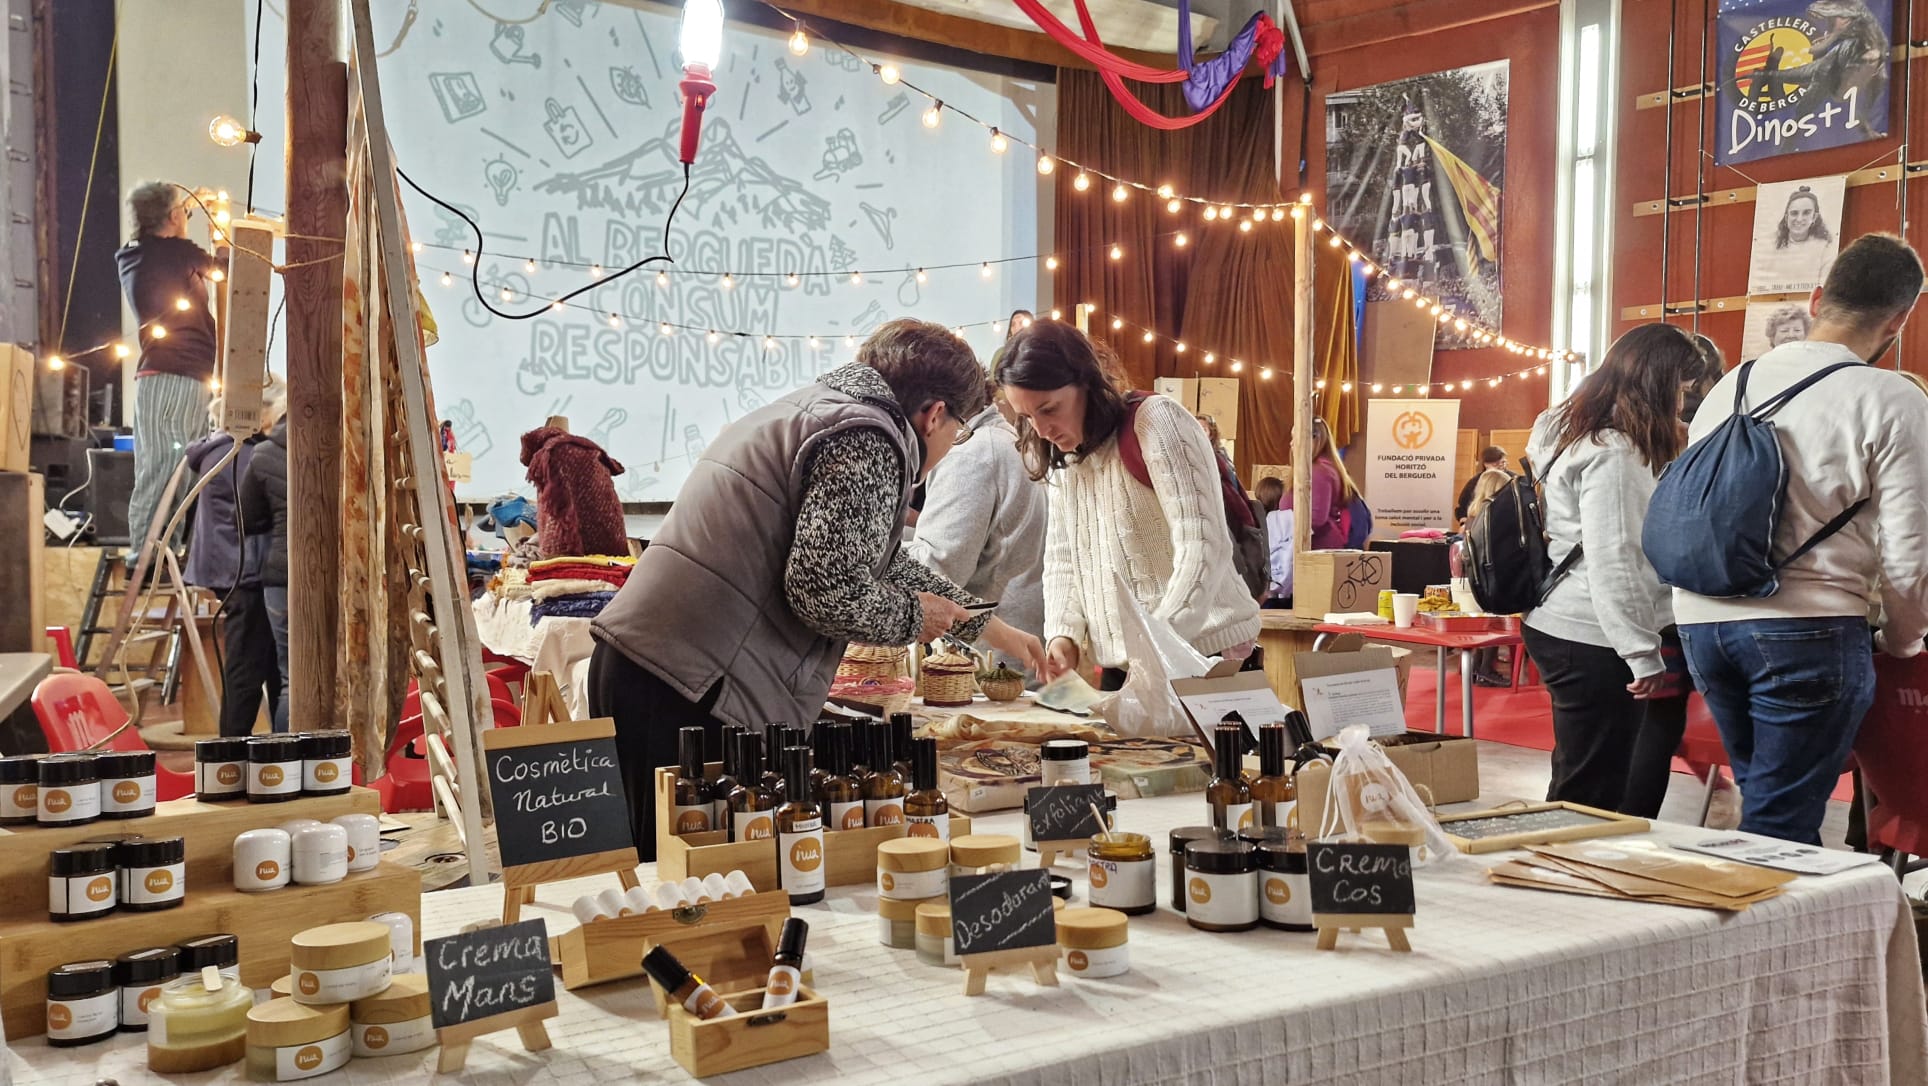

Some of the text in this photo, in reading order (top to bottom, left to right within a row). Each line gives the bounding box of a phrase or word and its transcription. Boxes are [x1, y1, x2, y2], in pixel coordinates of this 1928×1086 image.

[1734, 16, 1817, 53] CASTELLERS
[1739, 87, 1809, 113] DE BERGA
[541, 212, 591, 271] AL
[590, 277, 779, 335] CONSUM
[530, 319, 836, 390] RESPONSABLE
[1377, 454, 1414, 462] FUNDACIÓ
[495, 747, 616, 783] Cosmètica
[541, 817, 587, 844] BIO
[750, 827, 771, 839] nua
[795, 846, 819, 862] nua
[956, 868, 1051, 949] Desodorant
[1333, 879, 1382, 905] Cos
[443, 974, 536, 1022] Mans
